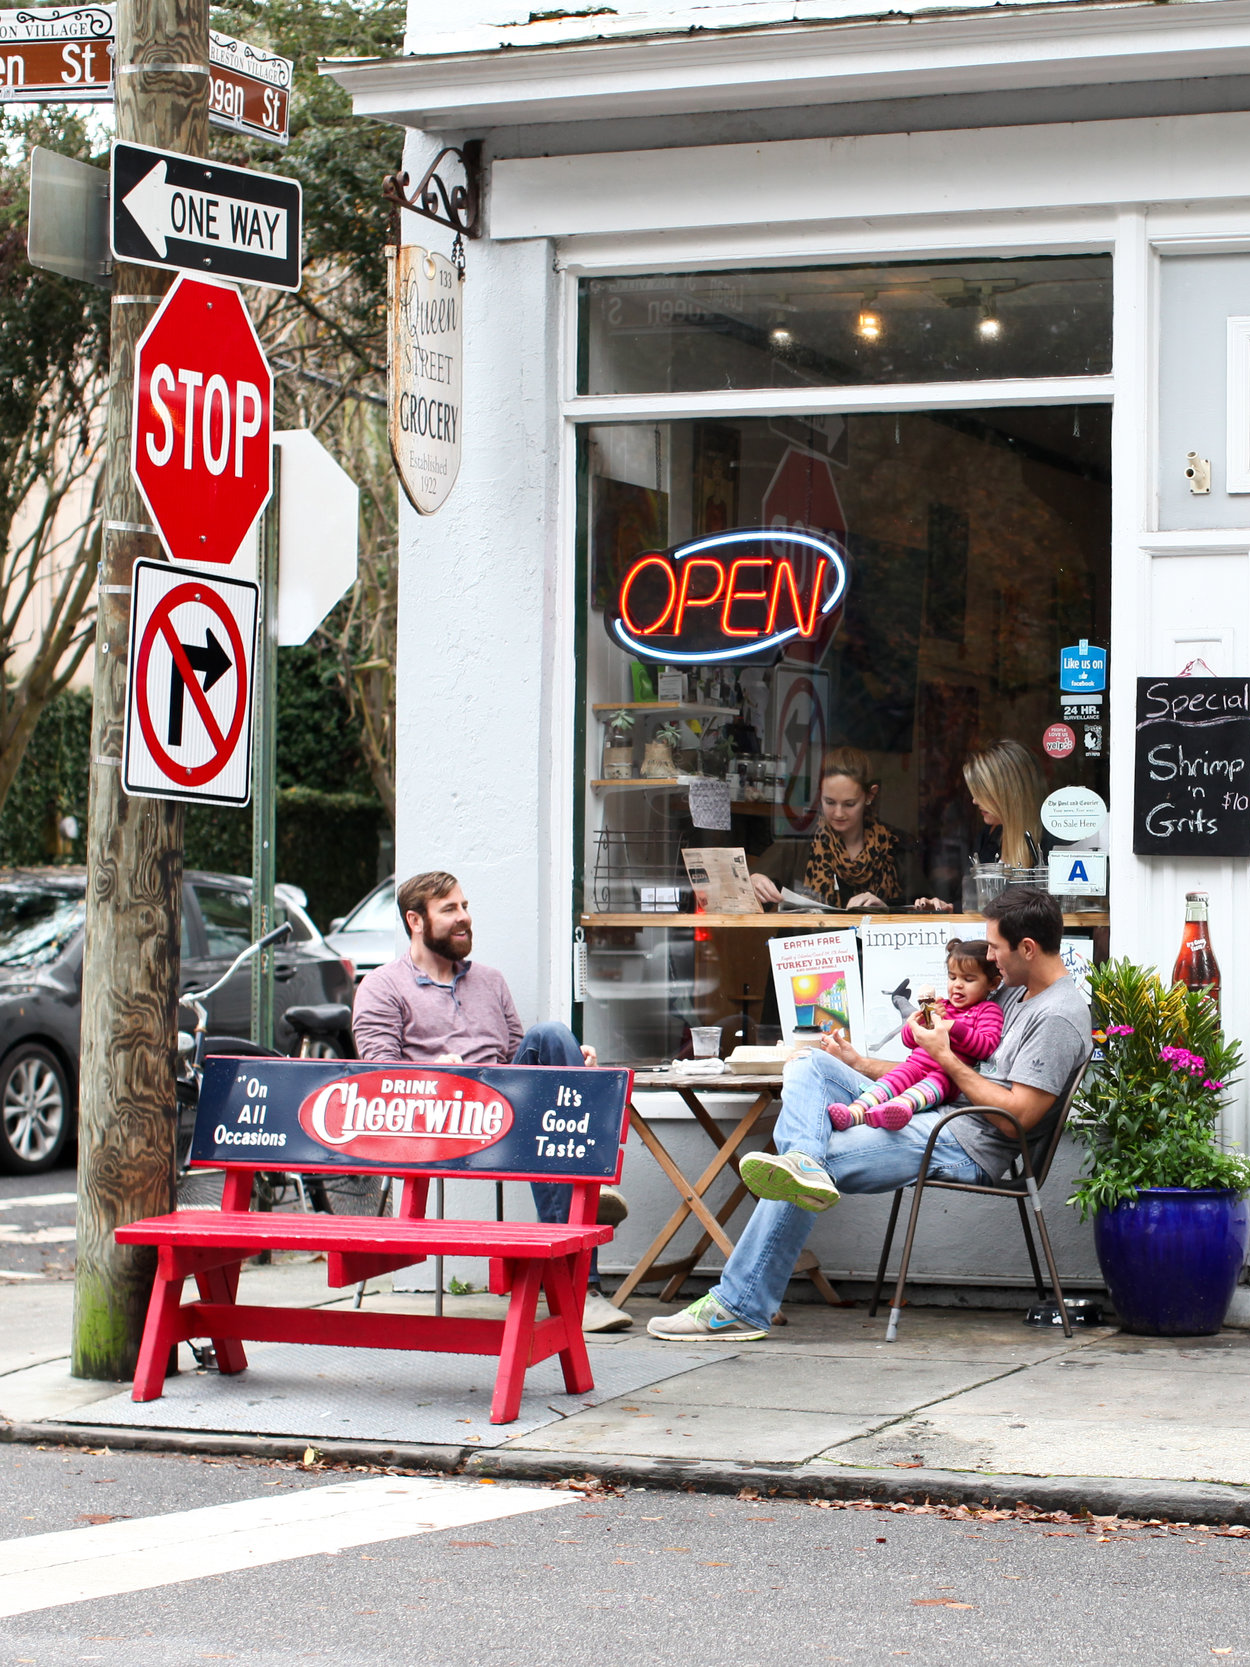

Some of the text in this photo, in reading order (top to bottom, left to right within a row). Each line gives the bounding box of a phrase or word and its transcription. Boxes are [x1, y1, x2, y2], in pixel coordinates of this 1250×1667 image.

[25, 22, 88, 37] VILLAGE
[61, 43, 96, 84] St
[247, 60, 278, 83] VILLAGE
[262, 87, 281, 130] St
[170, 191, 281, 251] ONE WAY
[439, 270, 452, 289] 133
[400, 267, 458, 362] Queen
[405, 344, 453, 386] STREET
[145, 362, 263, 479] STOP
[400, 391, 459, 445] GROCERY
[409, 451, 448, 476] Established
[420, 474, 437, 495] 1922
[619, 554, 827, 637] OPEN
[1063, 658, 1103, 669] Like us on
[1064, 705, 1100, 715] 24 HR.
[1146, 682, 1249, 720] Special
[1046, 740, 1064, 751] yelp
[1147, 743, 1245, 783] Shrimp
[1187, 785, 1205, 798] 'n
[1221, 791, 1249, 811] $10
[1051, 819, 1097, 828] On Sale Here
[1145, 802, 1219, 838] Grits
[1067, 860, 1089, 882] A
[783, 936, 841, 950] EARTH FARE
[866, 928, 948, 950] imprint
[776, 954, 855, 971] TURKEY DAY RUN
[381, 1079, 439, 1095] DRINK
[556, 1085, 582, 1107] It's
[237, 1105, 267, 1125] All
[312, 1082, 502, 1144] Cheerwine
[542, 1110, 590, 1134] Good
[213, 1128, 287, 1147] Occasions
